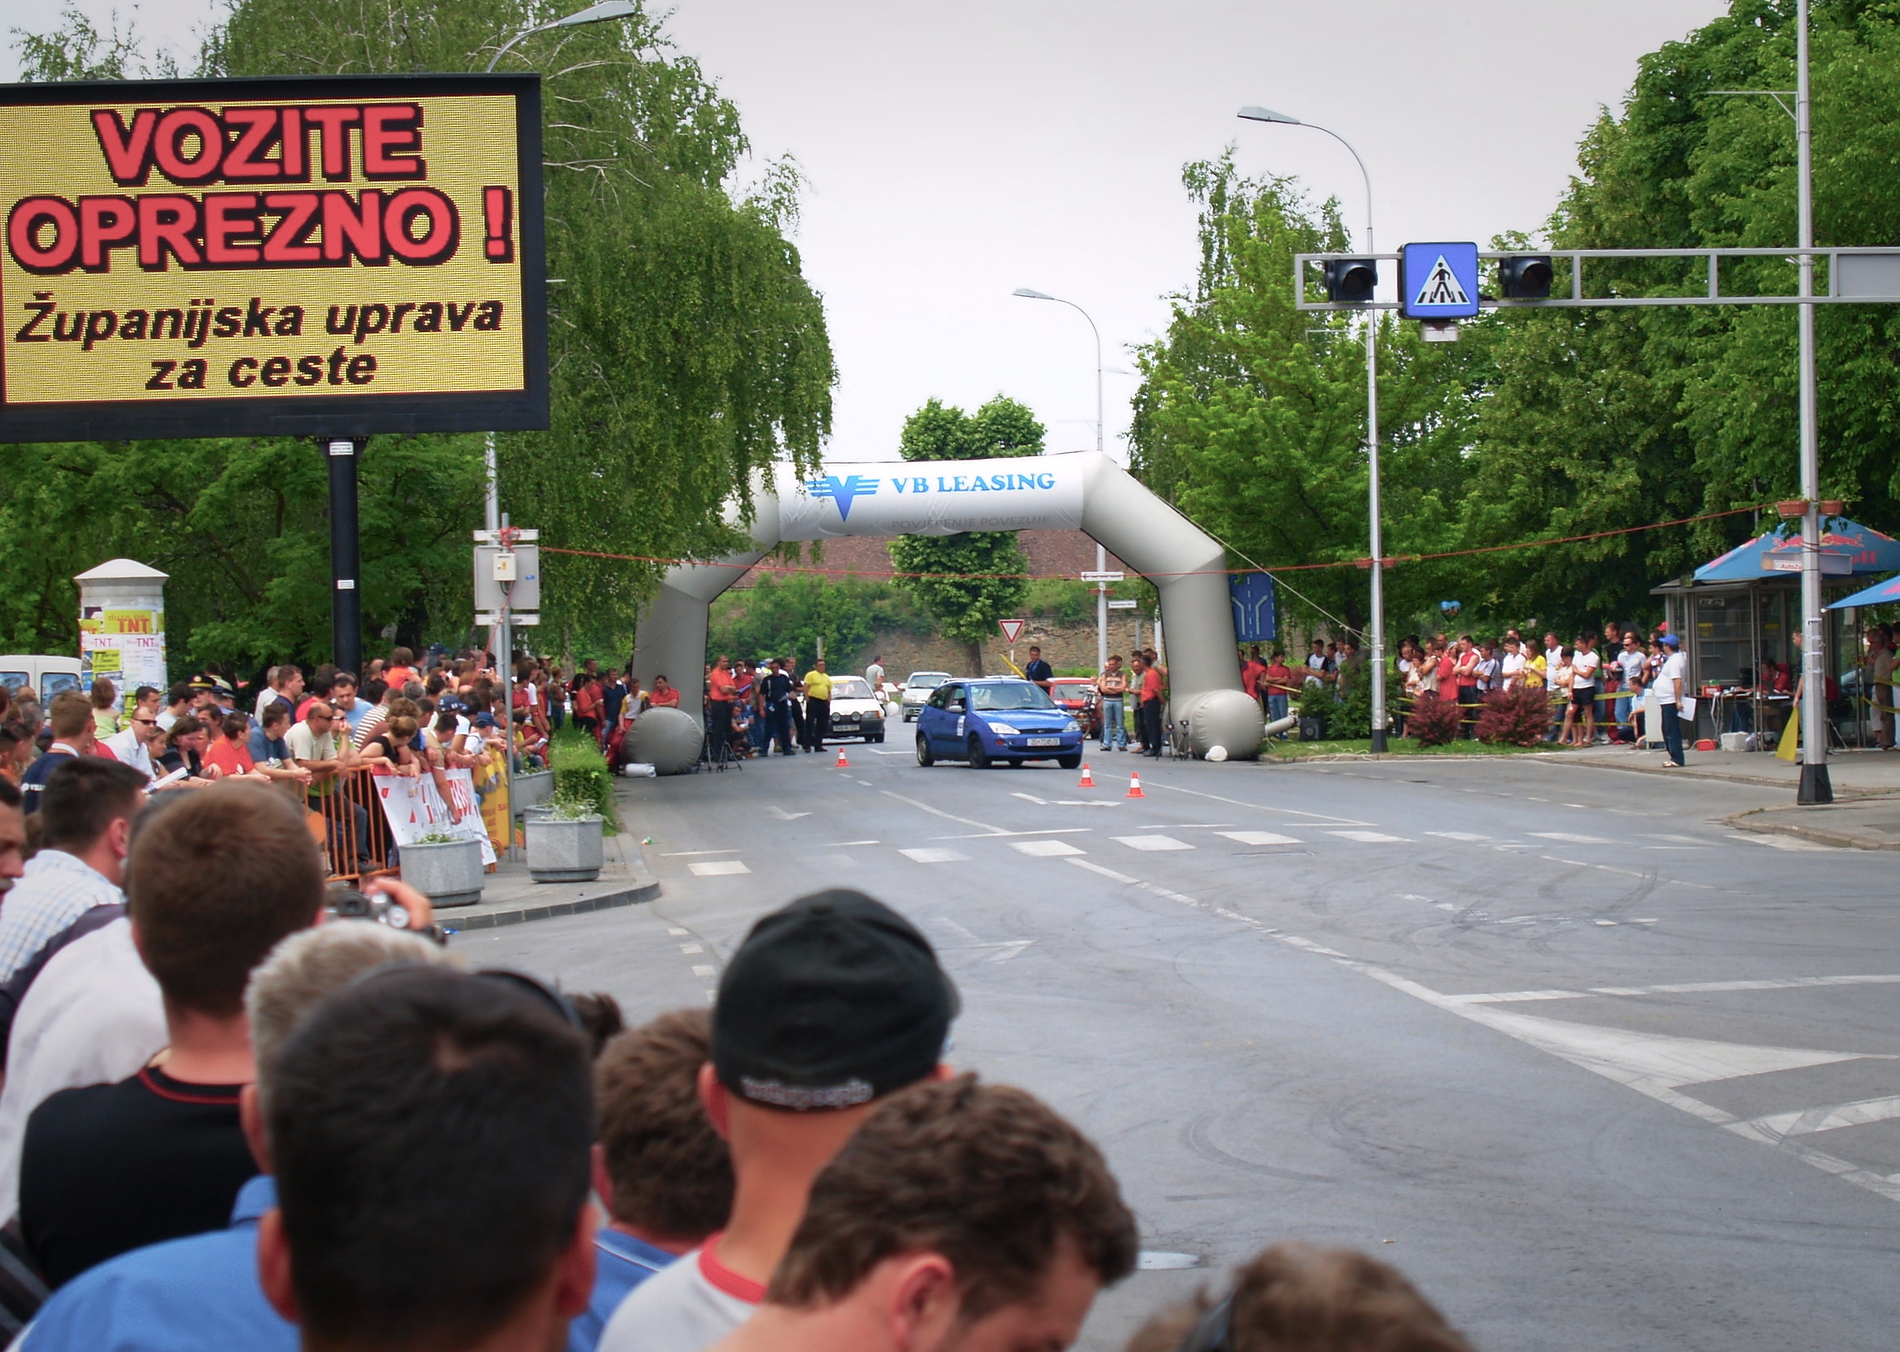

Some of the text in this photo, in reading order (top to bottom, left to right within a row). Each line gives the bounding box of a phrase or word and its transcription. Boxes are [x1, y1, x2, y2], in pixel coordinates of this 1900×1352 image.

[90, 103, 426, 187] VOZITE
[7, 185, 513, 275] OPREZNO !
[15, 292, 504, 350] Županijska uprava
[145, 346, 377, 390] za ceste
[891, 472, 1056, 494] VB LEASING
[980, 514, 1049, 528] POVEZUJE
[117, 617, 149, 634] TNT
[94, 637, 113, 648] TNT
[136, 637, 155, 648] TNT
